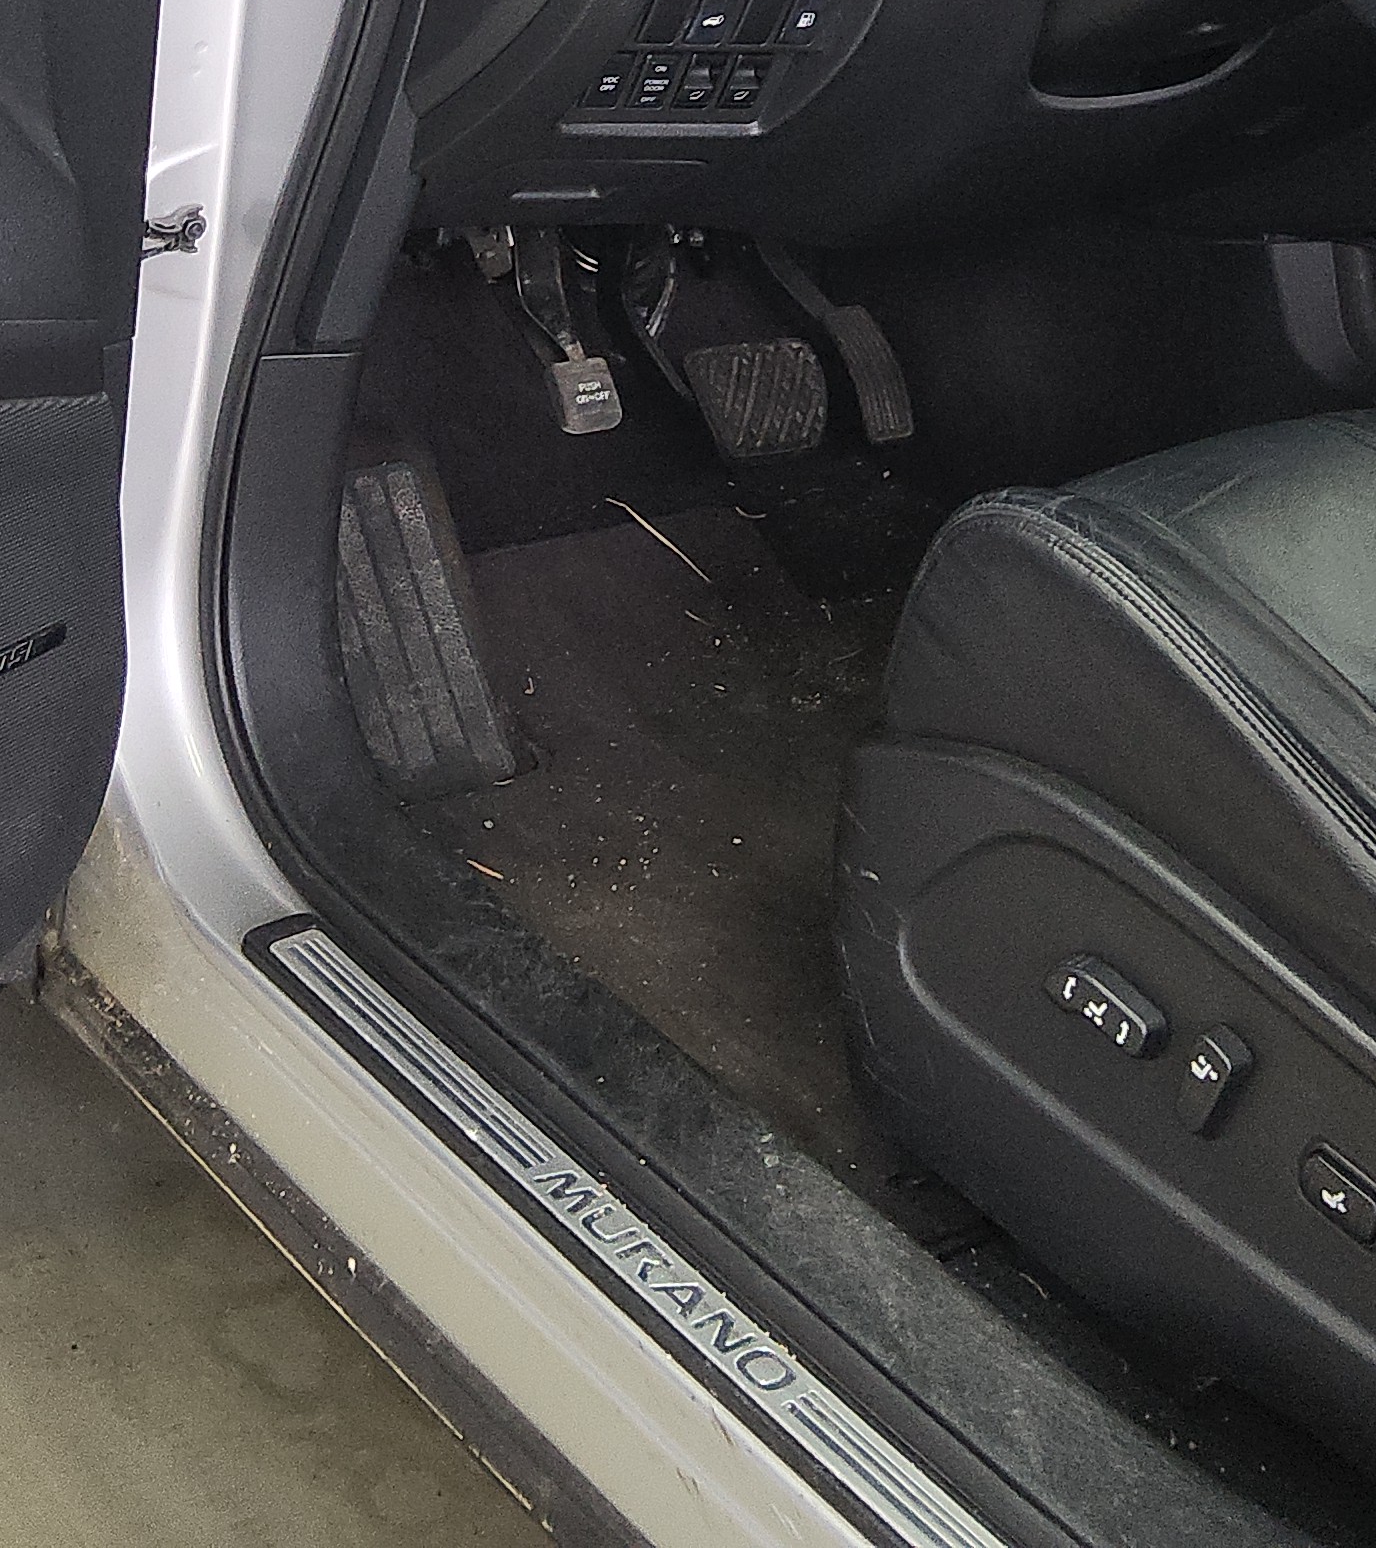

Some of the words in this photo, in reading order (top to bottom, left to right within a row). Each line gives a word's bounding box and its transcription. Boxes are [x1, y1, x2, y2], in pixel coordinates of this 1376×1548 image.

[602, 76, 621, 84] VDC
[599, 84, 616, 92] OFF
[532, 1169, 797, 1391] MURANO
